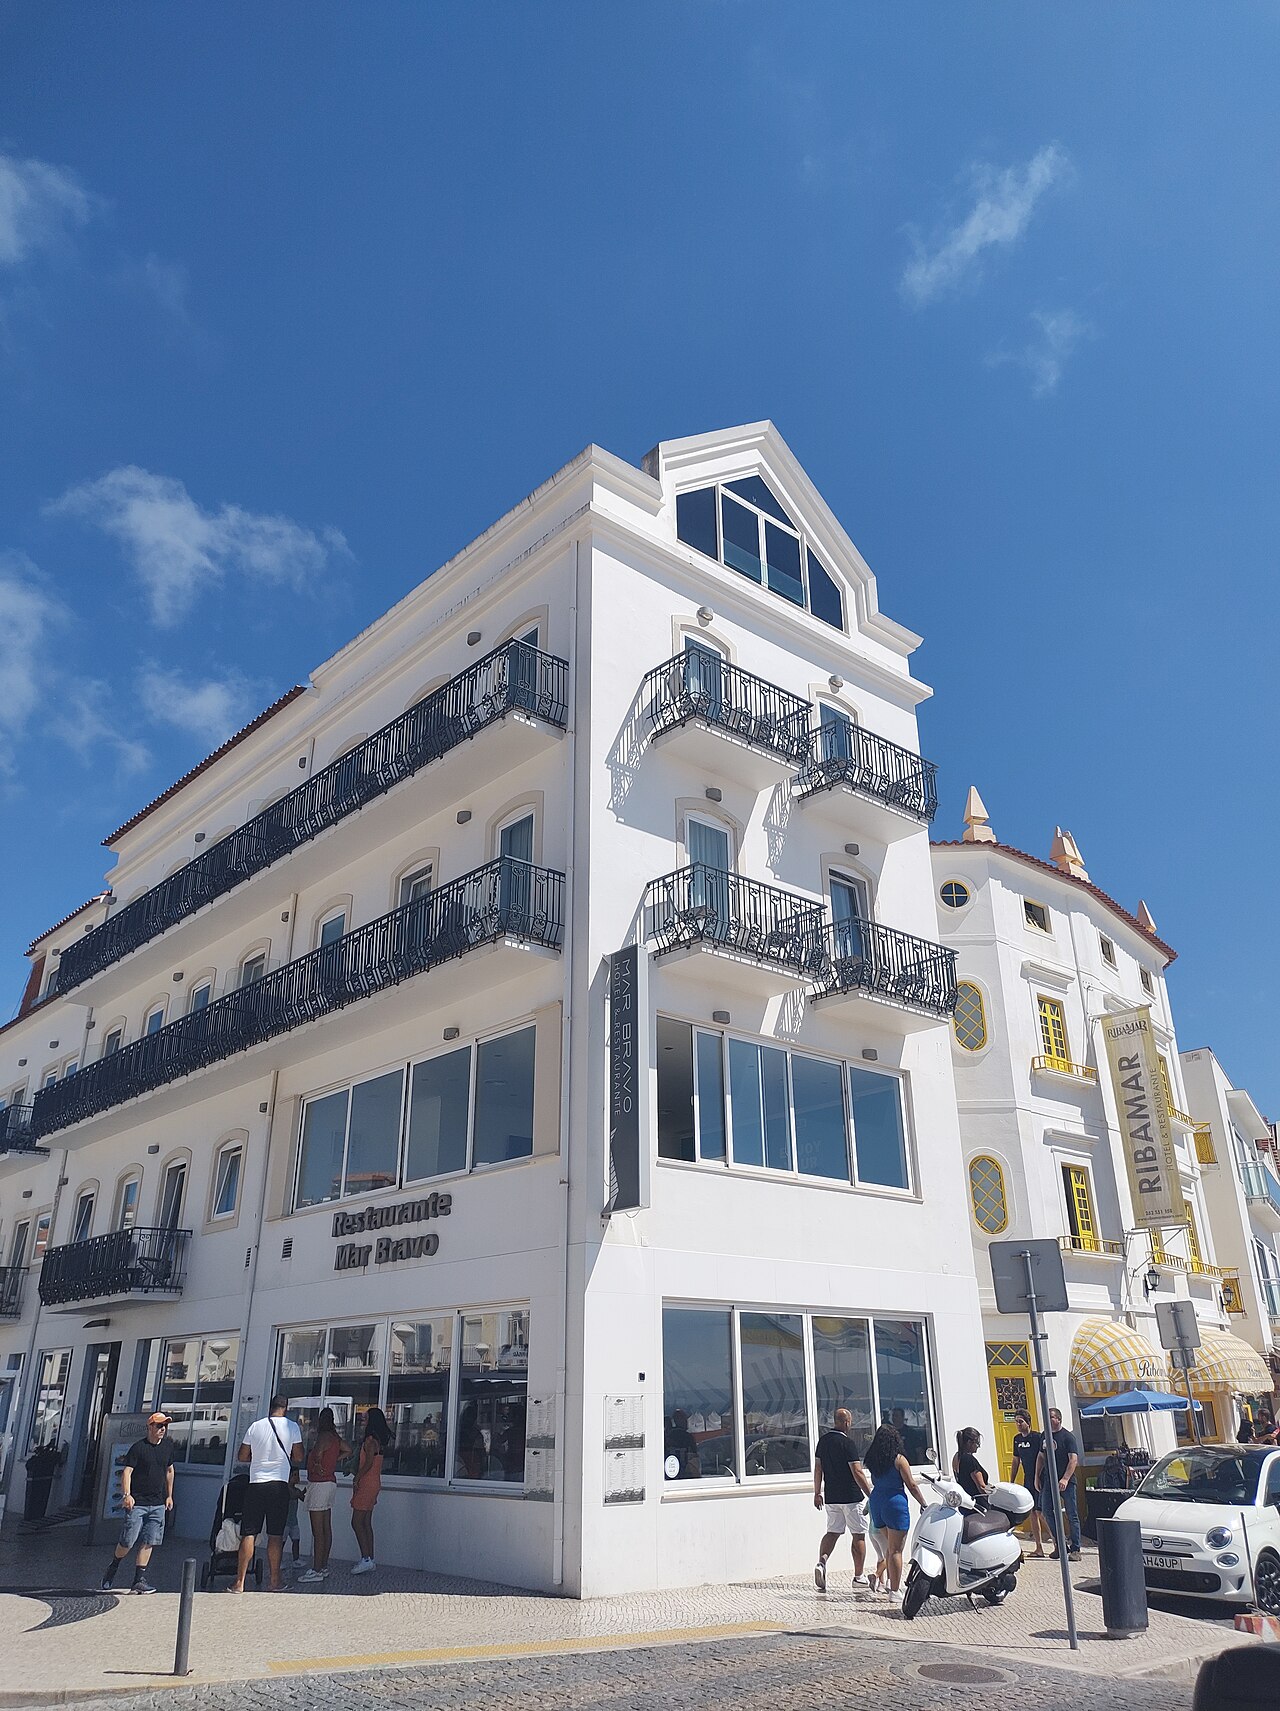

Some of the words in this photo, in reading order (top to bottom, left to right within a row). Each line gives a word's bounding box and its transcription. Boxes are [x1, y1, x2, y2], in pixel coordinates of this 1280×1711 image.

[622, 959, 631, 1012] MAR
[1107, 1020, 1148, 1039] RIBAMAR
[622, 1022, 632, 1113] BRAVO
[1150, 1067, 1167, 1129] RESTAURANTE
[1117, 1052, 1162, 1194] RIBAMAR
[1163, 1141, 1175, 1172] HOTEL
[332, 1192, 452, 1237] Restaurante
[334, 1243, 372, 1270] Mar
[375, 1233, 439, 1264] Bravo
